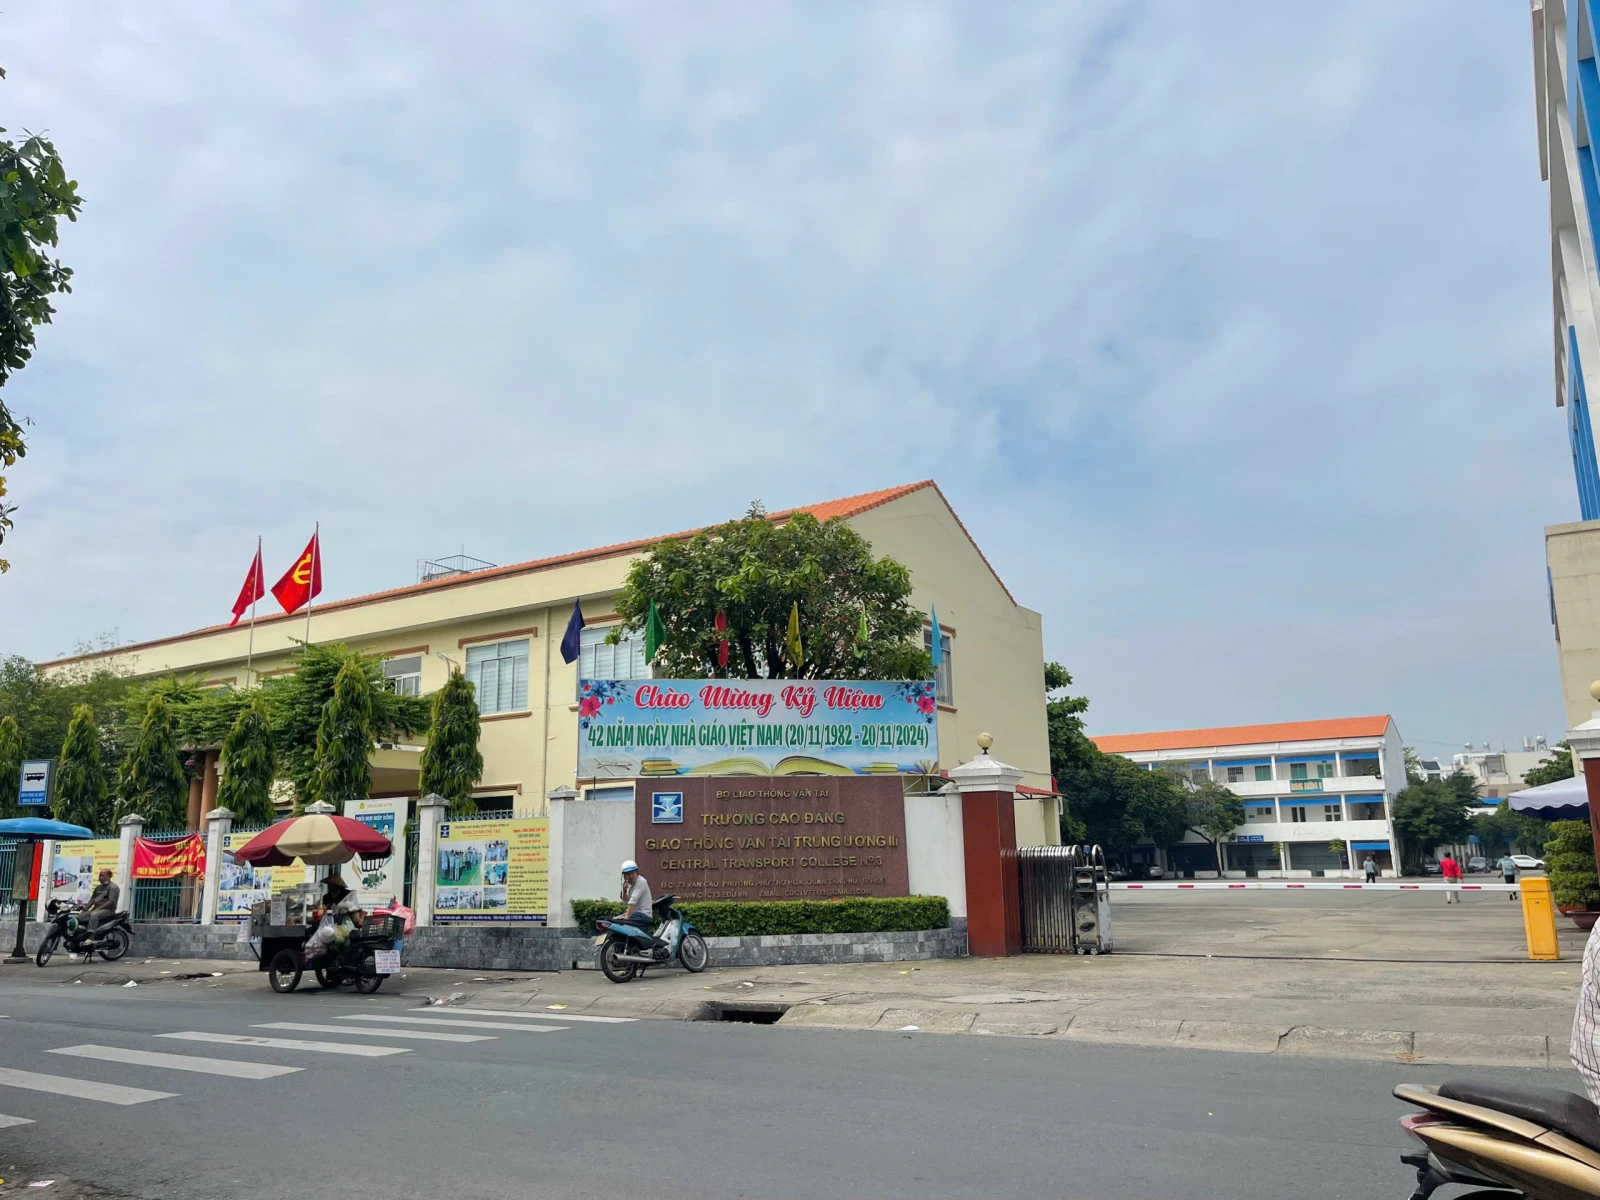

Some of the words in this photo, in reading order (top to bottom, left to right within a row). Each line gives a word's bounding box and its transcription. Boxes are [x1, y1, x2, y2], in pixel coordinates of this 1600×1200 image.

[634, 684, 692, 709] Chào
[699, 685, 775, 718] Mừng
[781, 685, 818, 718] Kỷ
[824, 685, 885, 712] Niệm
[587, 725, 604, 748] 42
[606, 717, 634, 748] NĂM
[636, 720, 669, 747] NGÀY
[672, 720, 697, 747] NHÀ
[698, 720, 726, 747] GIÁO
[729, 717, 755, 750] VIỆT
[756, 724, 783, 747] NAM
[784, 723, 853, 749] (20/11/1982
[861, 723, 930, 749] 20/11/2024)
[732, 790, 756, 798] GIAO
[700, 810, 765, 826] TRƯỜNG
[769, 812, 800, 825] CAO
[645, 838, 681, 851] GIAO
[684, 834, 734, 850] THÔNG
[793, 835, 841, 848] TRUNG
[660, 859, 719, 869] CENTRAL
[722, 857, 796, 869] TRANSPORT
[799, 856, 857, 867] COLLEGE
